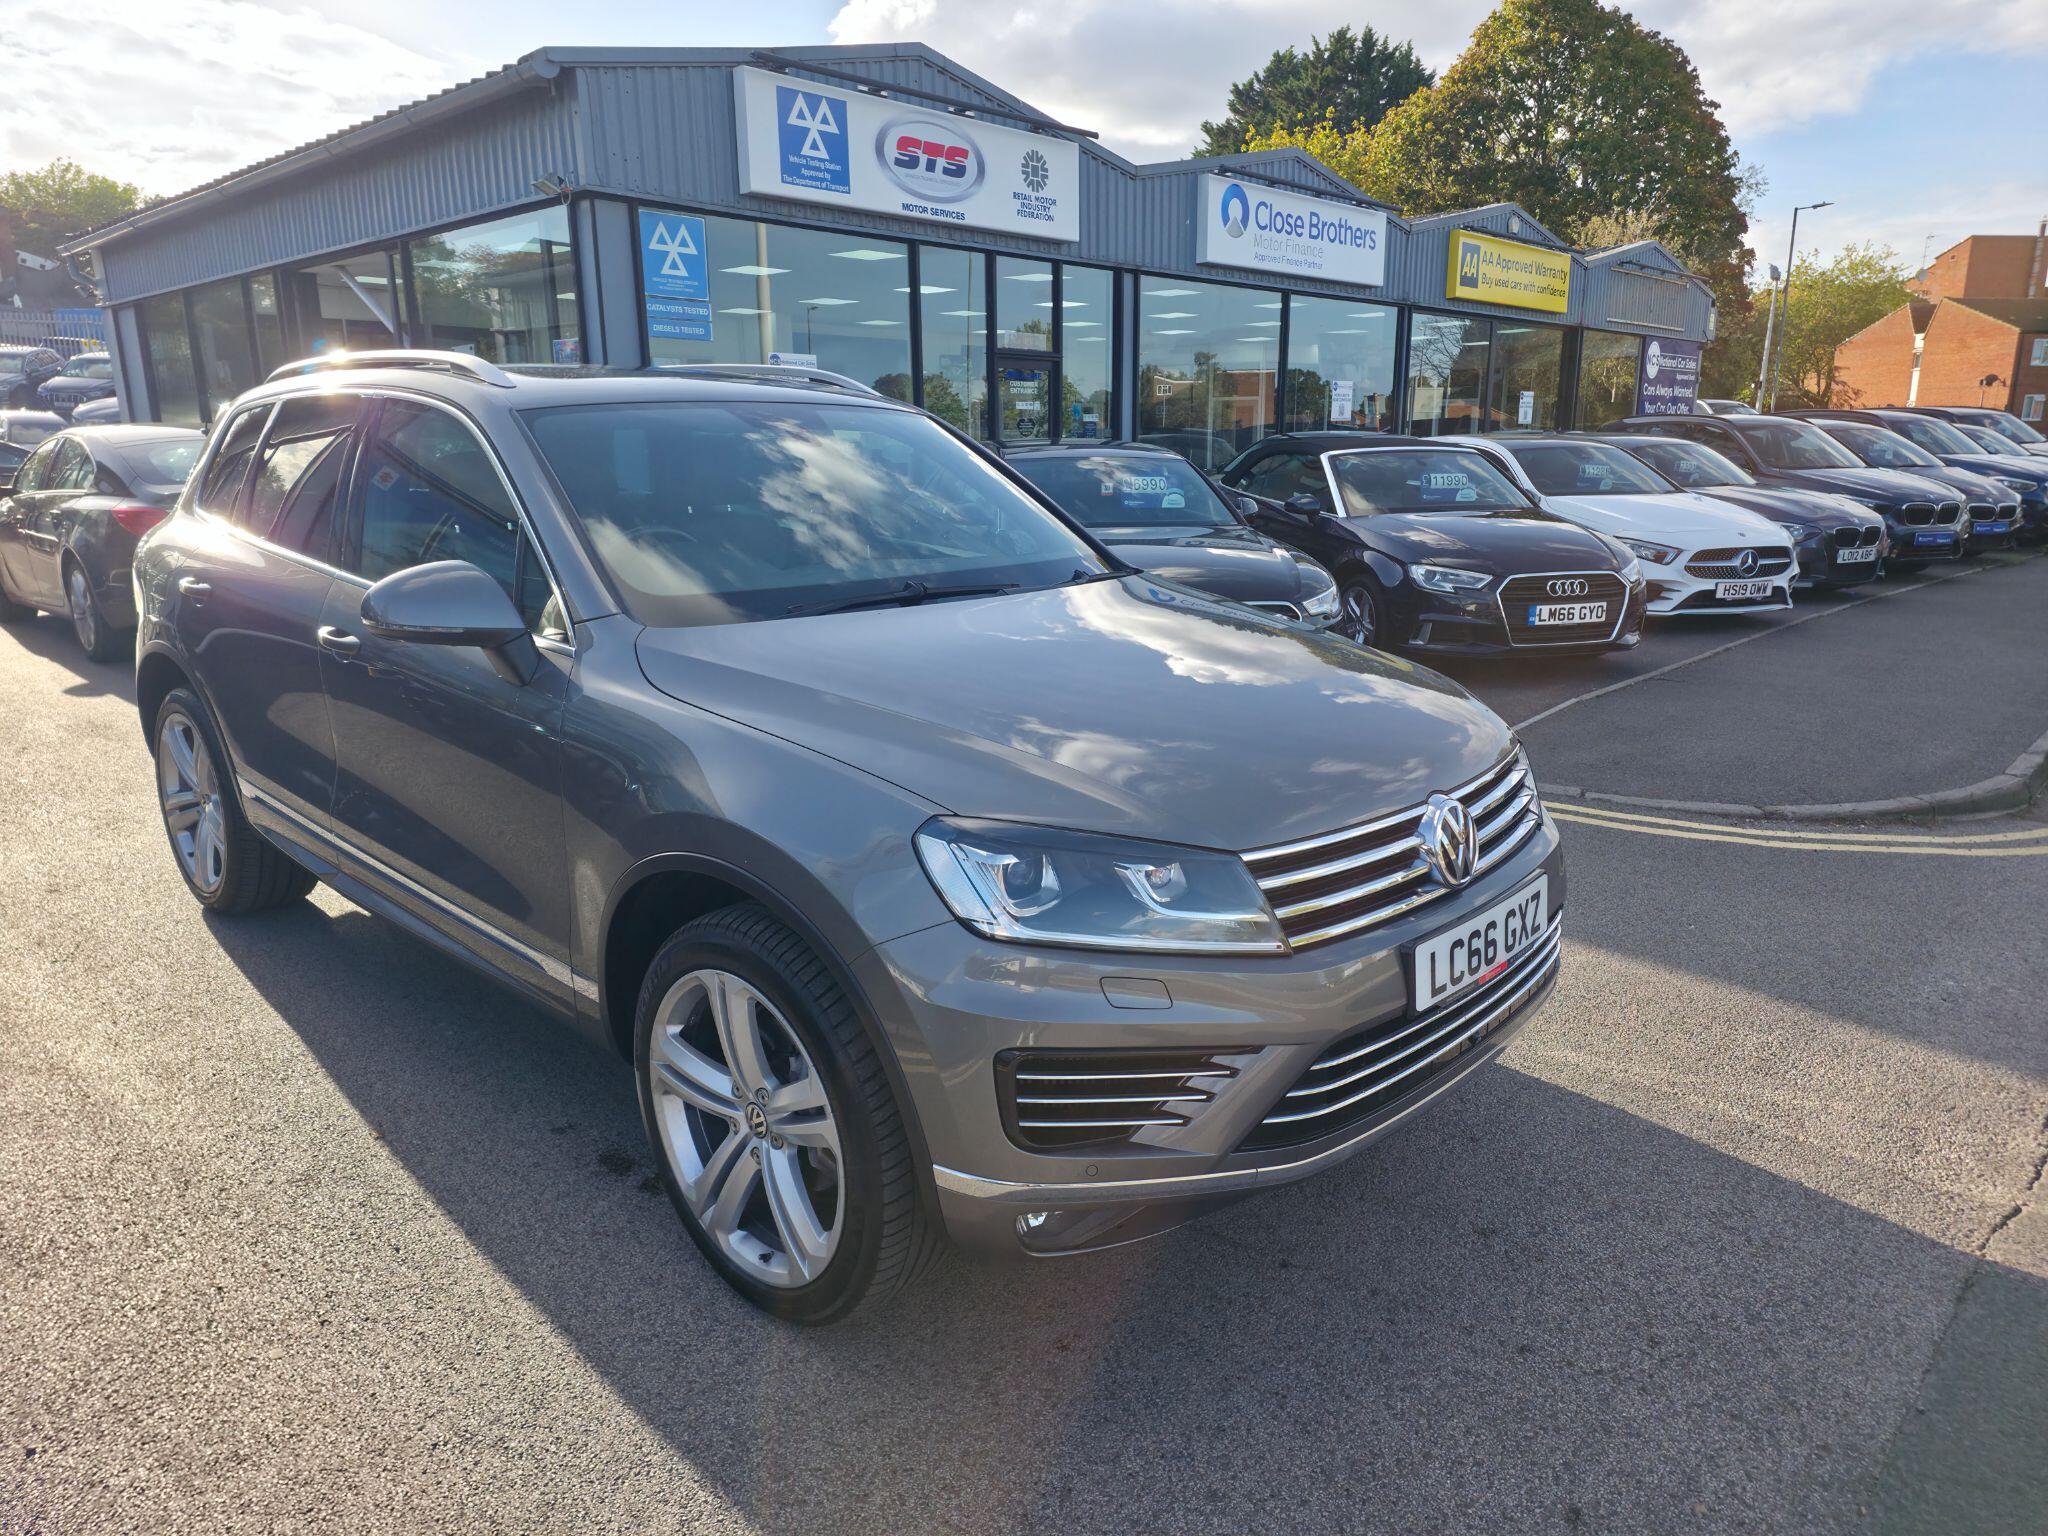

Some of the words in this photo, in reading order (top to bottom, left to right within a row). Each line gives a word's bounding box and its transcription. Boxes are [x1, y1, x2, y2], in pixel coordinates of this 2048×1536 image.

[789, 154, 806, 164] Vehicle
[807, 158, 824, 169] Testing
[825, 162, 841, 170] Station
[894, 136, 969, 178] STS
[801, 168, 823, 178] Approved
[825, 171, 830, 180] by
[793, 177, 820, 188] Department
[827, 182, 849, 192] Transport
[1013, 192, 1032, 202] RETAIL
[1034, 196, 1056, 206] MOTOR
[902, 203, 928, 215] MOTOR
[930, 208, 966, 220] SERVICES
[1020, 202, 1050, 213] INDUSTRY
[1017, 210, 1054, 222] FEDERATION
[1255, 201, 1304, 237] Close
[1309, 212, 1376, 250] Brothers
[1253, 234, 1282, 251] Motor
[1285, 239, 1323, 259] Finance
[1253, 252, 1281, 264] Approved
[1282, 256, 1303, 267] Finance
[1304, 260, 1323, 270] Partner
[1462, 253, 1477, 277] AA
[1482, 251, 1494, 266] AA
[1496, 254, 1533, 274] Approved
[1535, 262, 1568, 284] Warranty
[1482, 273, 1493, 288] Buy
[1494, 277, 1509, 288] used
[1510, 280, 1522, 290] cars
[1524, 281, 1536, 292] with
[1537, 284, 1565, 297] confidence
[647, 304, 682, 312] CATALYSTS
[684, 307, 708, 315] TESTED
[653, 324, 679, 332] DIESELS
[1660, 356, 1677, 367] National
[1686, 359, 1696, 369] Sales
[1644, 384, 1655, 395] Cars
[1656, 384, 1673, 398] Always
[1644, 402, 1655, 413] Your
[1667, 403, 1676, 414] Our
[1433, 475, 1467, 486] 11990
[1723, 584, 1748, 596] HS19
[1538, 606, 1575, 622] LM66
[1579, 605, 1604, 620] GYO
[1430, 920, 1497, 998] LC66
[1504, 890, 1541, 954] GXZ
